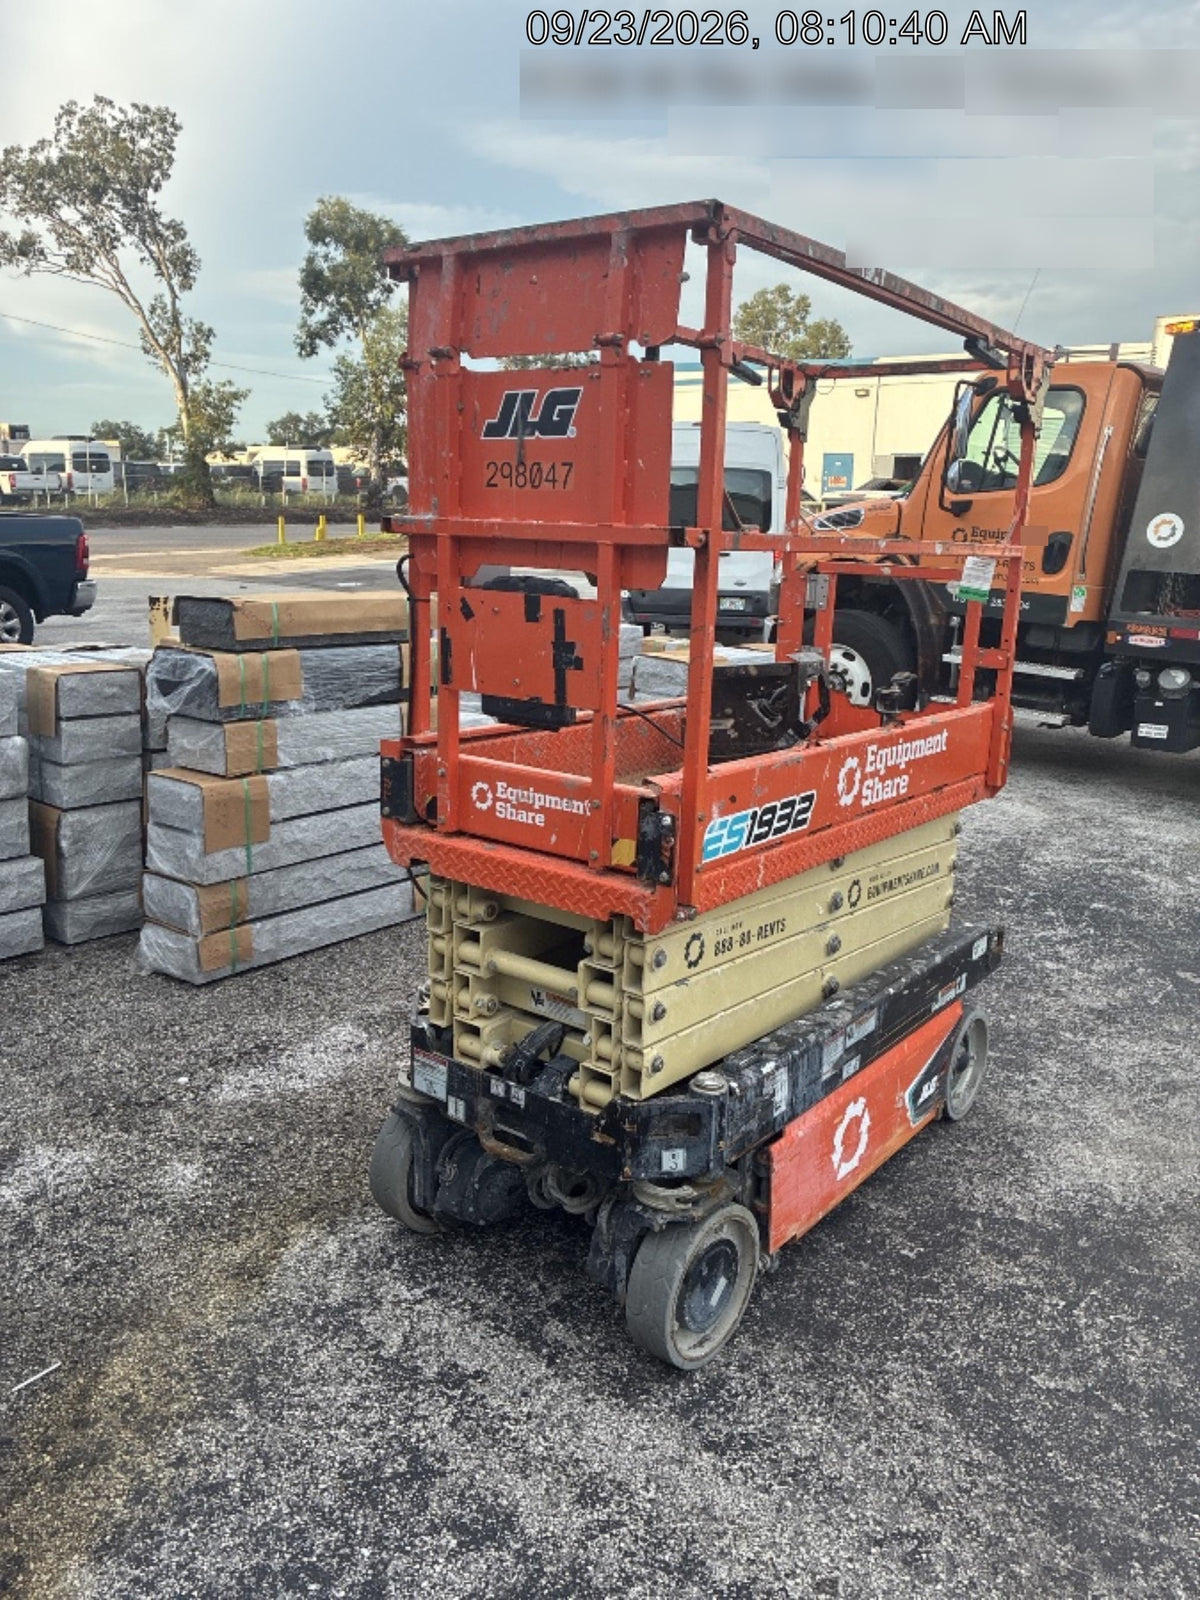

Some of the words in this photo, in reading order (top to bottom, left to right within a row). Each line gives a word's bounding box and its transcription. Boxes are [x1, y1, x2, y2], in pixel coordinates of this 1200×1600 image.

[480, 386, 584, 439] JLG
[485, 461, 574, 490] 298047
[865, 729, 949, 775] Equipment
[496, 781, 591, 817] Equipment
[861, 774, 909, 807] Share
[496, 802, 545, 827] Share
[702, 789, 817, 864] ES1932
